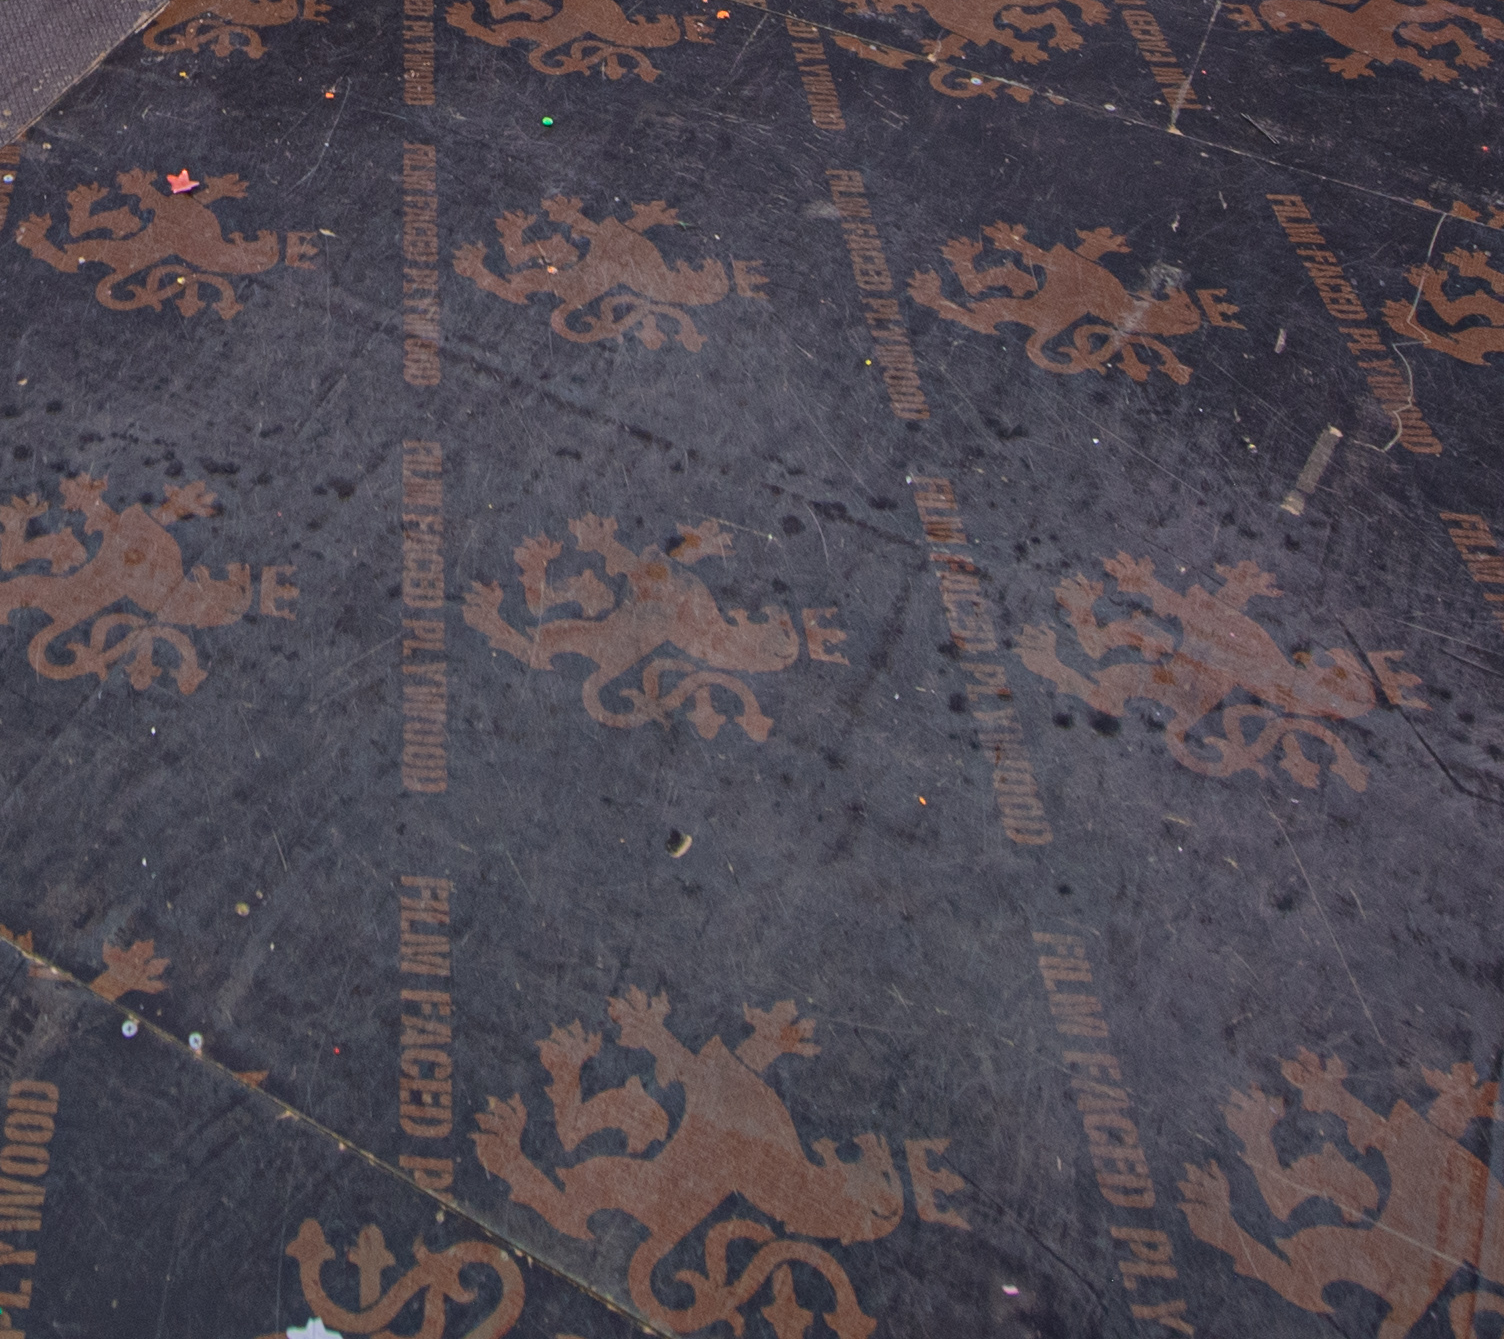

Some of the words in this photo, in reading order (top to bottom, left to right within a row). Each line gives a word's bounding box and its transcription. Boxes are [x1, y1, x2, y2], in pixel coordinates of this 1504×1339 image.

[402, 439, 443, 507] FILM
[402, 513, 446, 609] FACED
[401, 619, 448, 794] PLYWOOD
[398, 875, 453, 976] FILM
[1033, 930, 1110, 1039] FILM
[398, 988, 454, 1139] FACED
[1063, 1051, 1156, 1210] FACED
